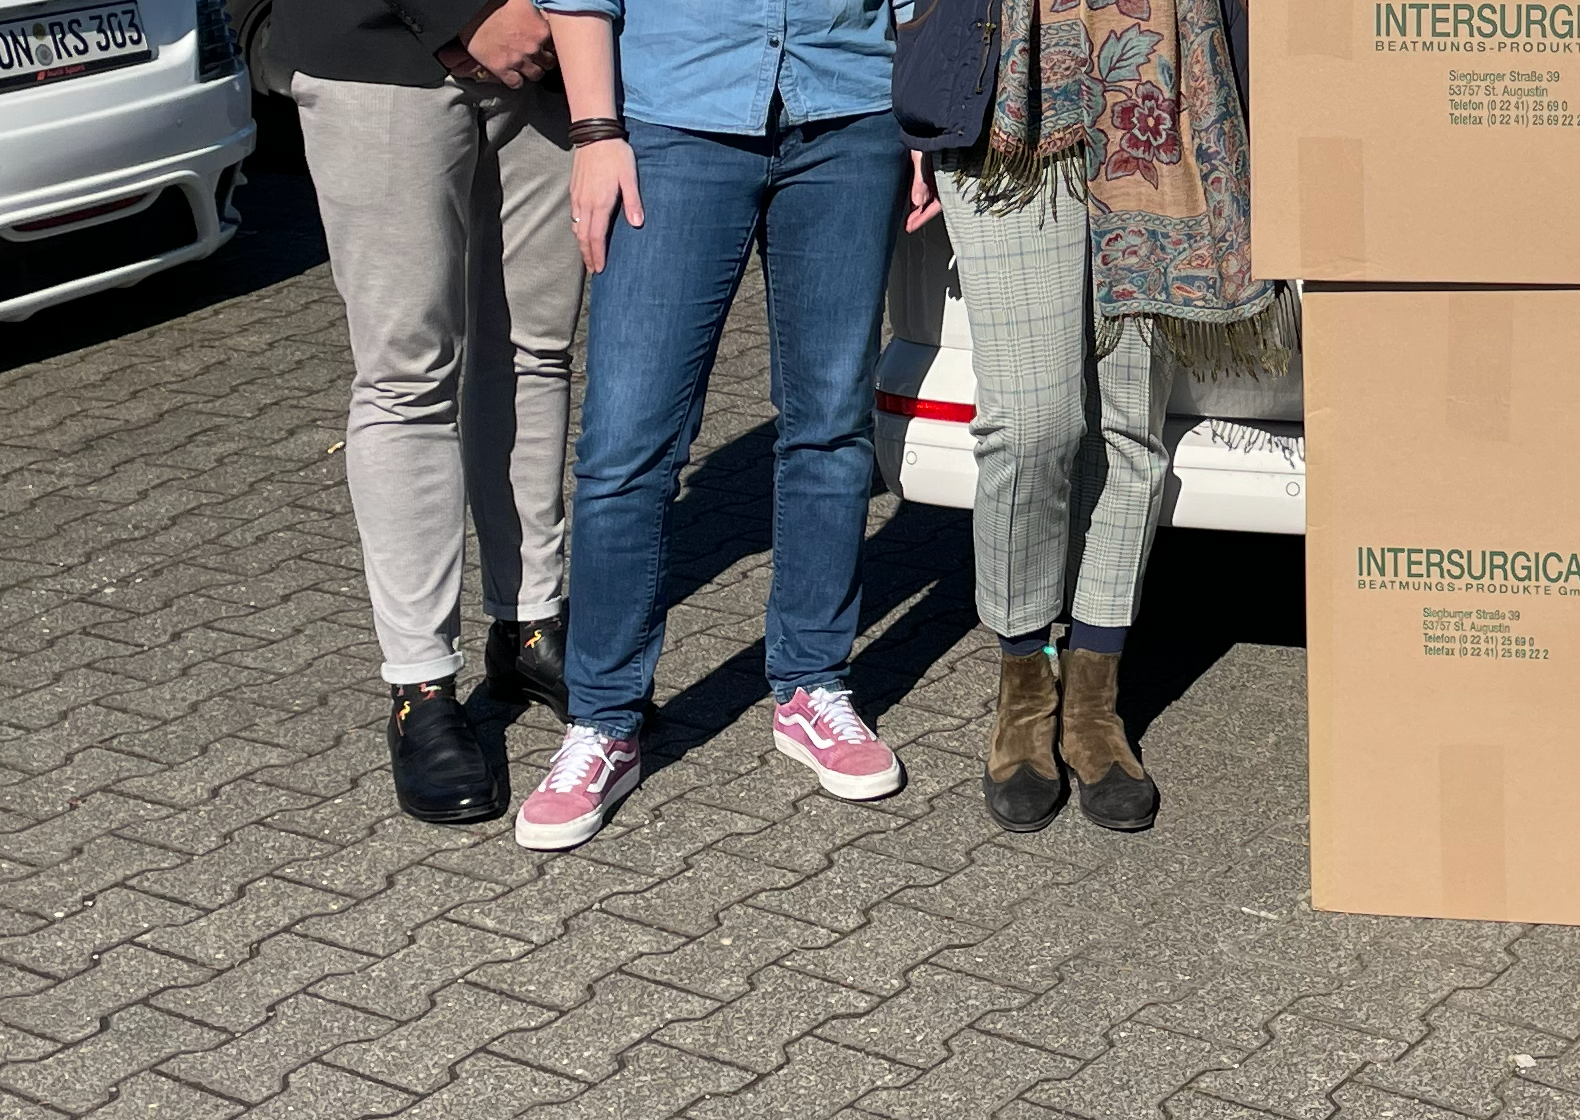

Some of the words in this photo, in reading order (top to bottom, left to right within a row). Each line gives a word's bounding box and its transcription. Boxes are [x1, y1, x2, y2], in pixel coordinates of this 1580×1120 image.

[48, 18, 89, 60] RS
[89, 9, 142, 51] 303
[1449, 70, 1506, 84] Siegburger
[1509, 71, 1543, 82] Straße
[1547, 71, 1560, 82] 39
[1449, 85, 1481, 96] 53757
[1484, 86, 1498, 97] St.
[1502, 86, 1548, 99] Augustin
[1449, 99, 1484, 112] Telefon
[1487, 100, 1497, 113] (0
[1499, 101, 1511, 112] 22
[1514, 100, 1529, 113] 41)
[1532, 101, 1544, 112] 25
[1547, 101, 1559, 112] 69
[1562, 102, 1568, 112] 0
[1449, 113, 1483, 125] Telefax
[1487, 114, 1497, 127] (0
[1499, 114, 1511, 126] 22
[1514, 114, 1529, 128] 41)
[1532, 115, 1544, 126] 25
[1547, 115, 1559, 126] 69
[1562, 115, 1573, 127] 22
[1358, 580, 1551, 596] BEATMUNGS-PRODUKTE
[1423, 608, 1472, 621] Siegburger
[1476, 610, 1506, 620] Straße
[1508, 610, 1520, 620] 39
[1423, 620, 1451, 630] 53757
[1454, 622, 1465, 631] St.
[1469, 622, 1510, 634] Augustin
[1423, 633, 1456, 644] Telefon
[1459, 635, 1468, 645] (0
[1470, 635, 1481, 644] 22
[1484, 636, 1498, 646] 41)
[1501, 636, 1512, 646] 25
[1515, 637, 1526, 646] 69
[1529, 638, 1534, 646] 0
[1424, 646, 1455, 656] Telefax
[1459, 647, 1468, 658] (0
[1470, 648, 1481, 657] 22
[1484, 648, 1498, 660] 41)
[1501, 649, 1512, 658] 25
[1515, 649, 1526, 658] 69
[1529, 650, 1540, 659] 22
[1543, 650, 1549, 659] 2
